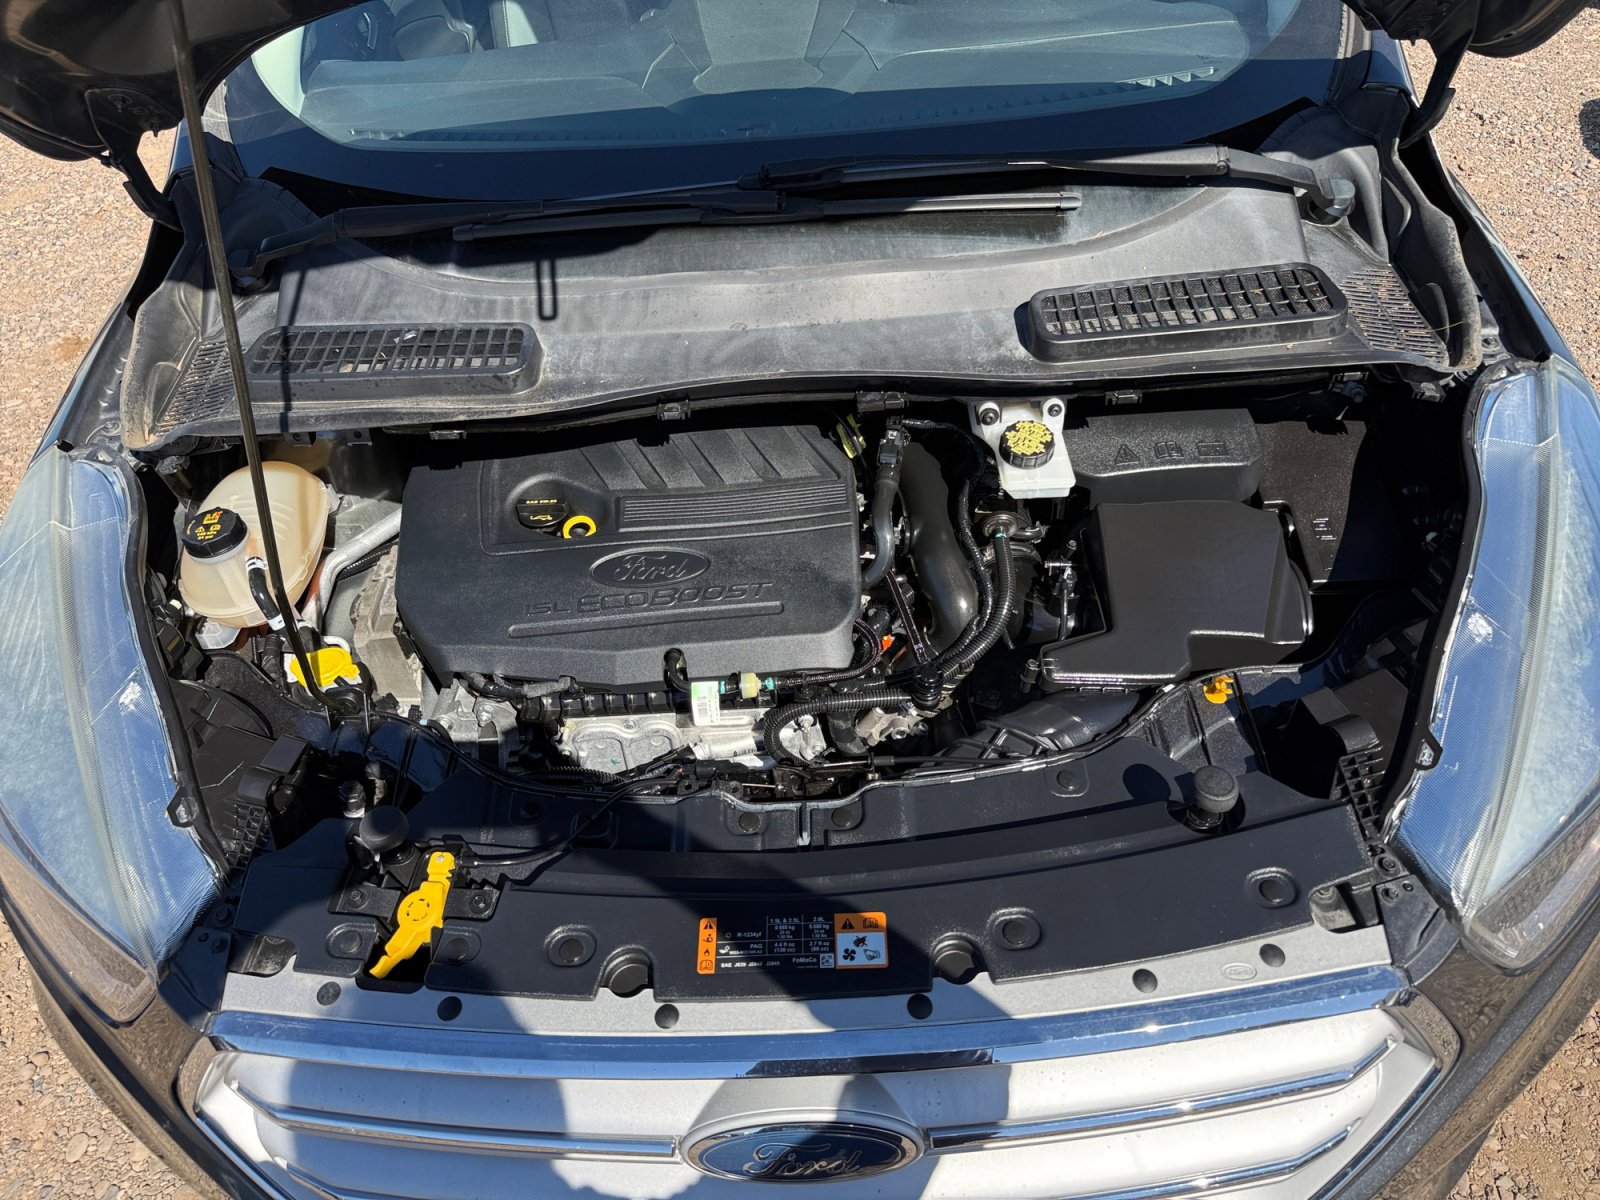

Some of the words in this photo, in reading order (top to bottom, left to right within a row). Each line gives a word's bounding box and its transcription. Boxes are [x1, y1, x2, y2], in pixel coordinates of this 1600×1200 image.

[613, 553, 689, 582] Ford
[792, 956, 818, 964] FoMoCo
[742, 1142, 863, 1177] Ford
